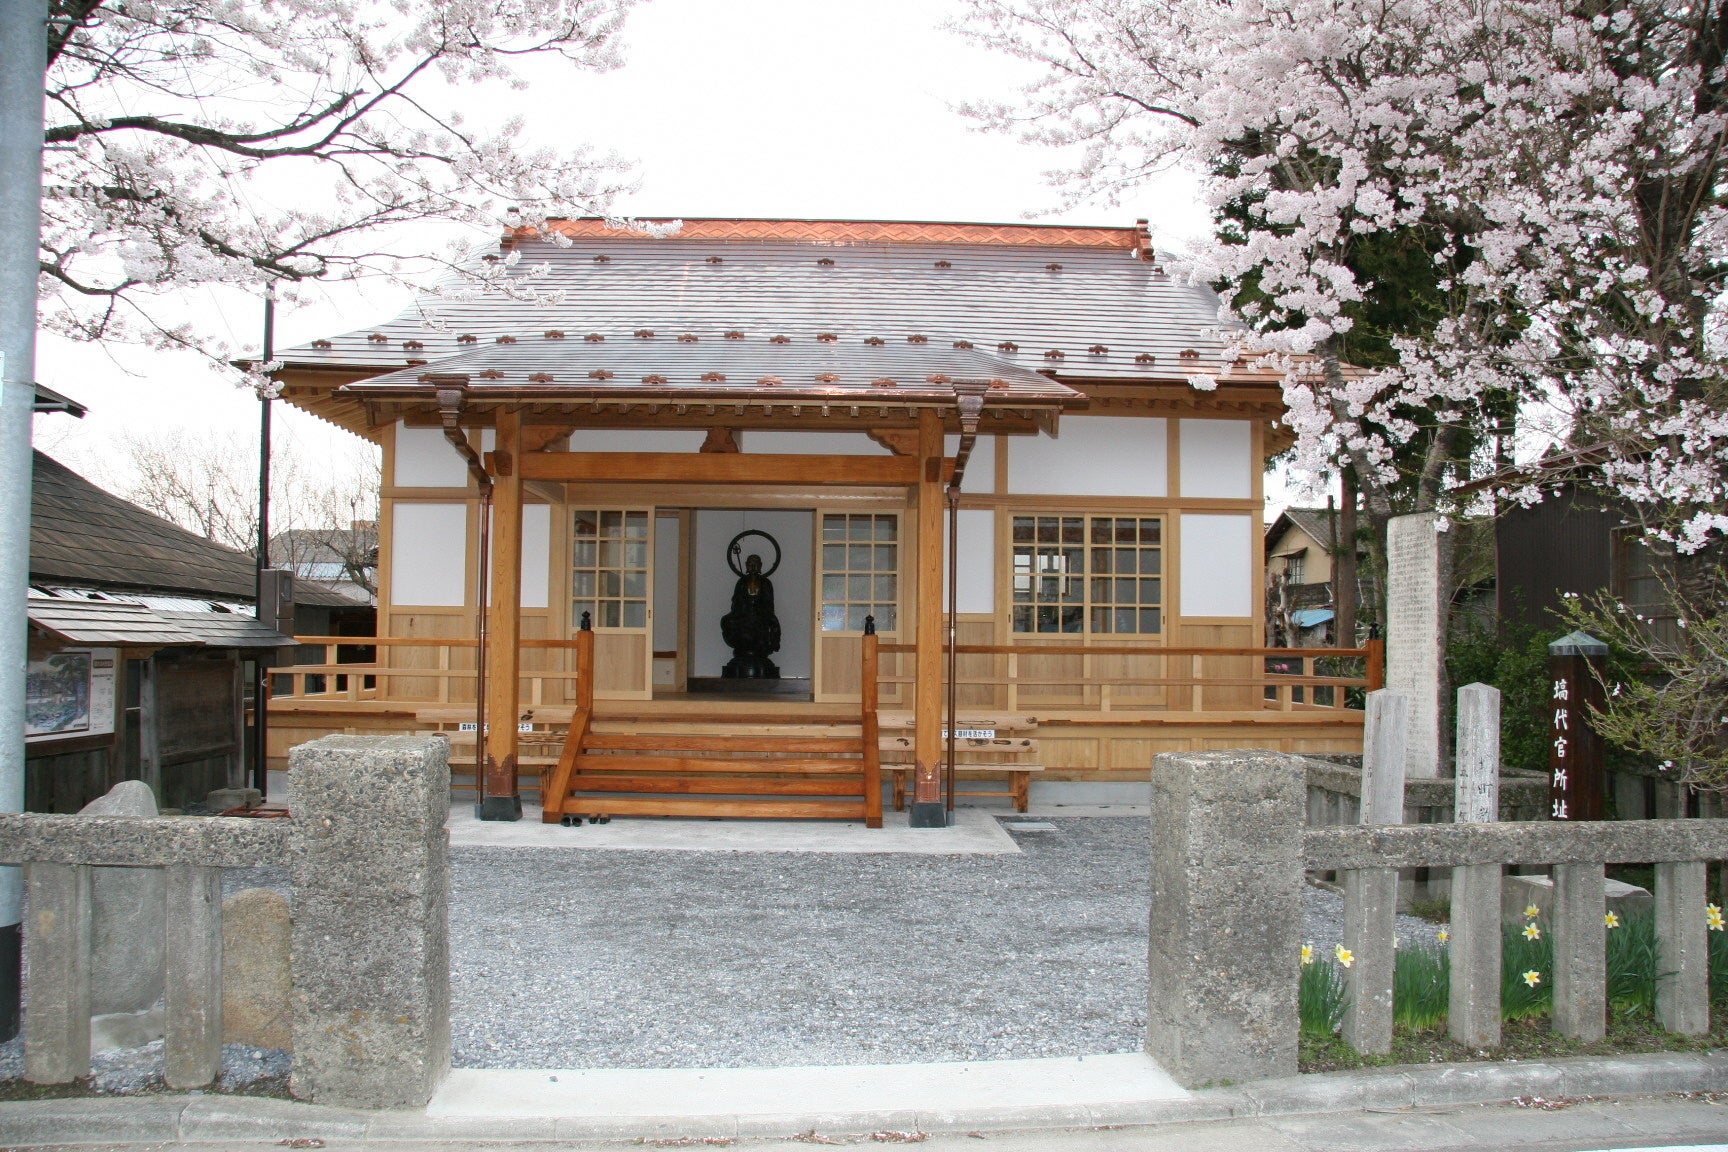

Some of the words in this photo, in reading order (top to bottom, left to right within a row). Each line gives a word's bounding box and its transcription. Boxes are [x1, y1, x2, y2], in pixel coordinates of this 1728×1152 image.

[1552, 678, 1568, 819] 塙代官所址
